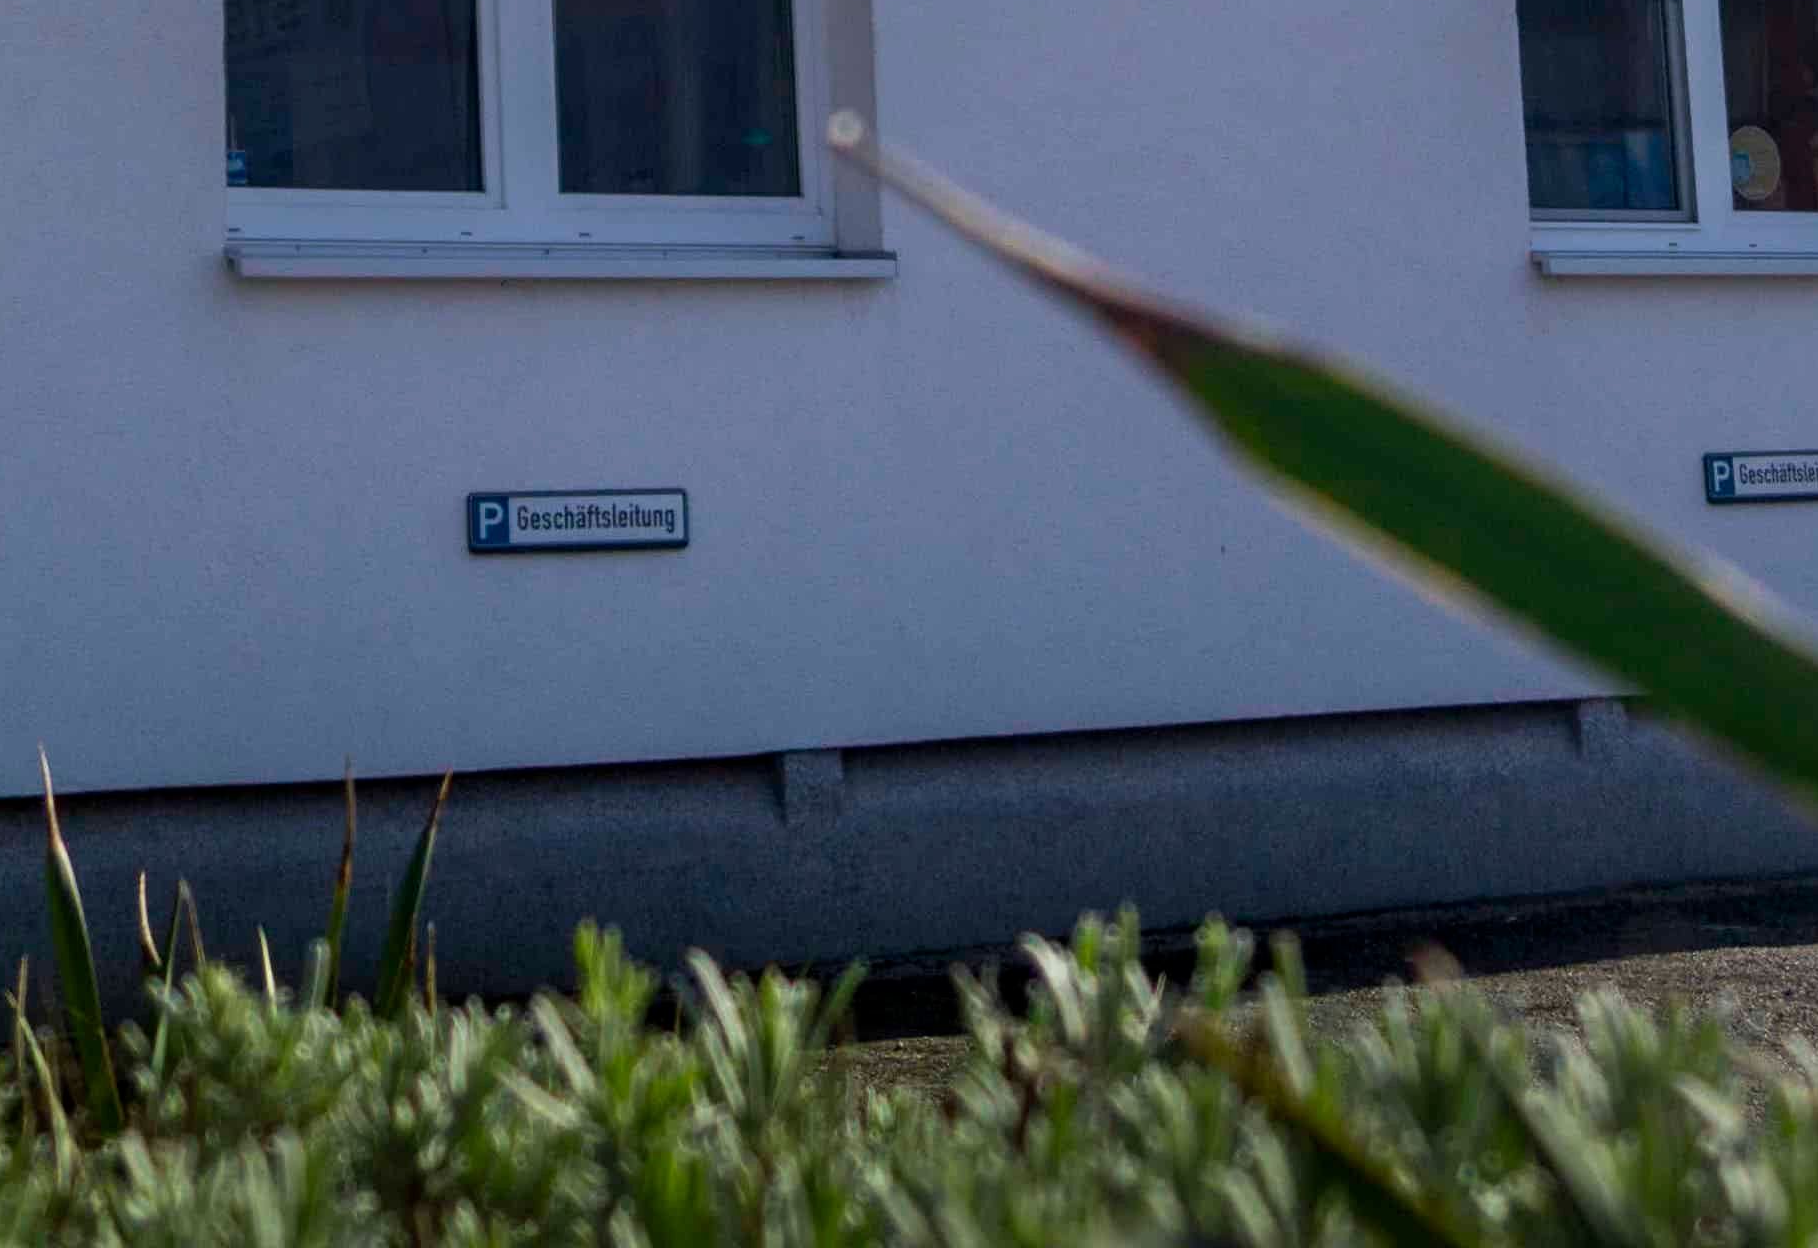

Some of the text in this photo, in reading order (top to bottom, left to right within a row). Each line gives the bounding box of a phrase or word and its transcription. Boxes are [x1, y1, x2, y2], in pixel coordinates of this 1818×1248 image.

[1712, 460, 1730, 493] P
[478, 501, 677, 540] P Geschäftsleitung
